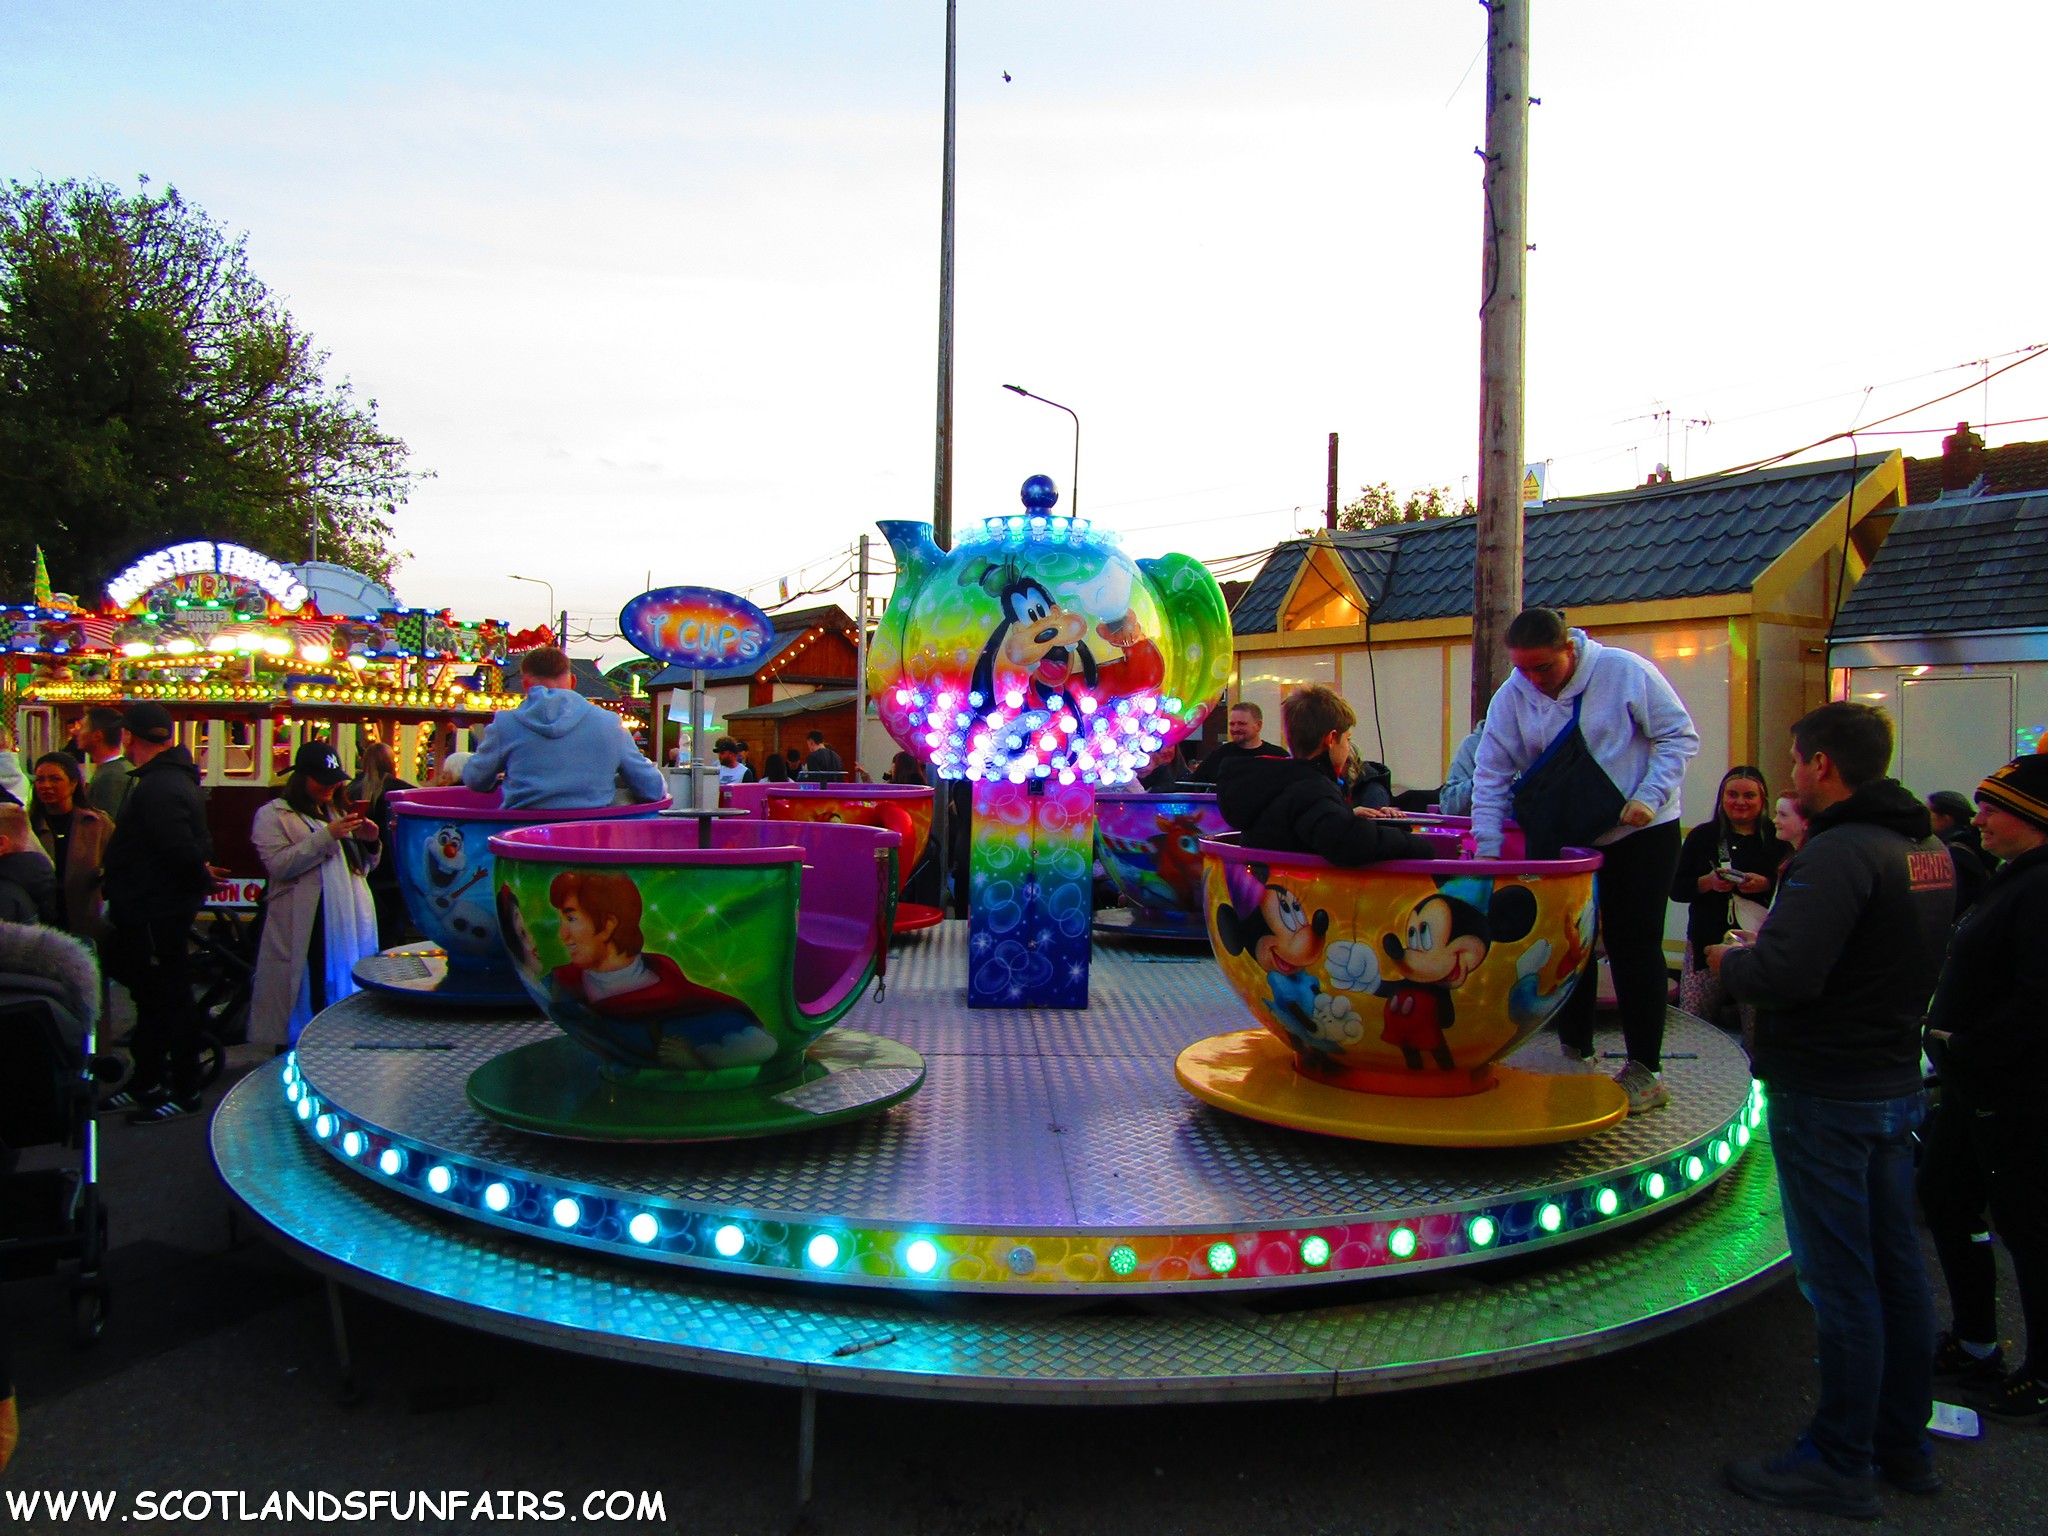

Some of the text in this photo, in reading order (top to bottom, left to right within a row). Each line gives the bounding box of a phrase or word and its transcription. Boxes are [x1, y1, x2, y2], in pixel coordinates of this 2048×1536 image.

[107, 541, 309, 612] MONSTER TRUCKS
[176, 609, 230, 622] MONSTER
[646, 611, 760, 656] T CUPS
